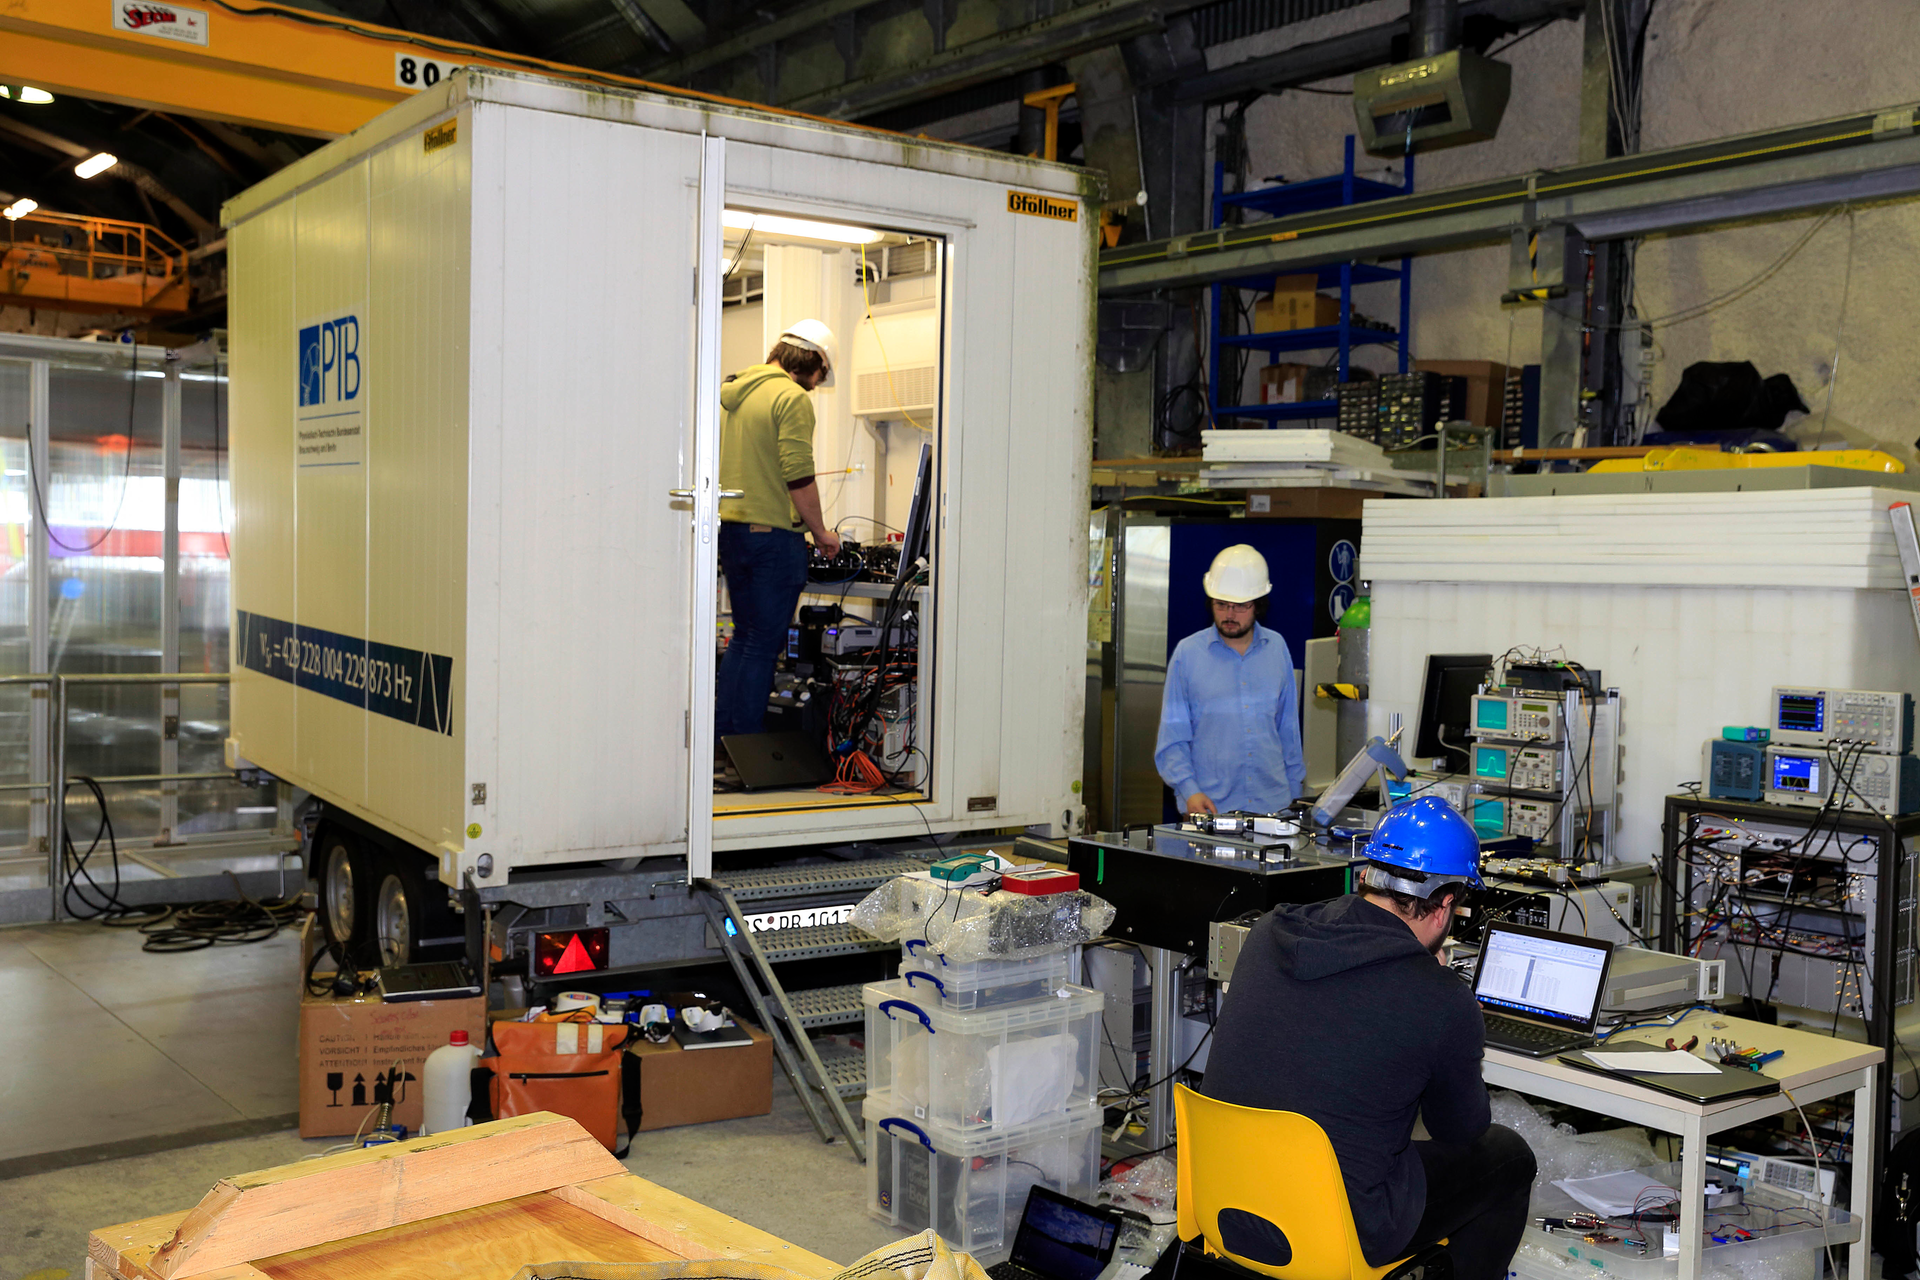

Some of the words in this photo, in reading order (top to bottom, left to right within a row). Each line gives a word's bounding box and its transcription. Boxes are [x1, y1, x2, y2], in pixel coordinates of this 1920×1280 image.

[400, 58, 460, 87] 80
[1010, 194, 1075, 219] Gföllner
[322, 315, 361, 404] PTB
[282, 636, 301, 669] 429
[302, 641, 321, 676] 228
[322, 647, 343, 682] 004
[344, 652, 367, 690] 229
[368, 658, 392, 697] 873
[394, 663, 413, 703] Hz
[319, 1046, 360, 1055] VORSICHT
